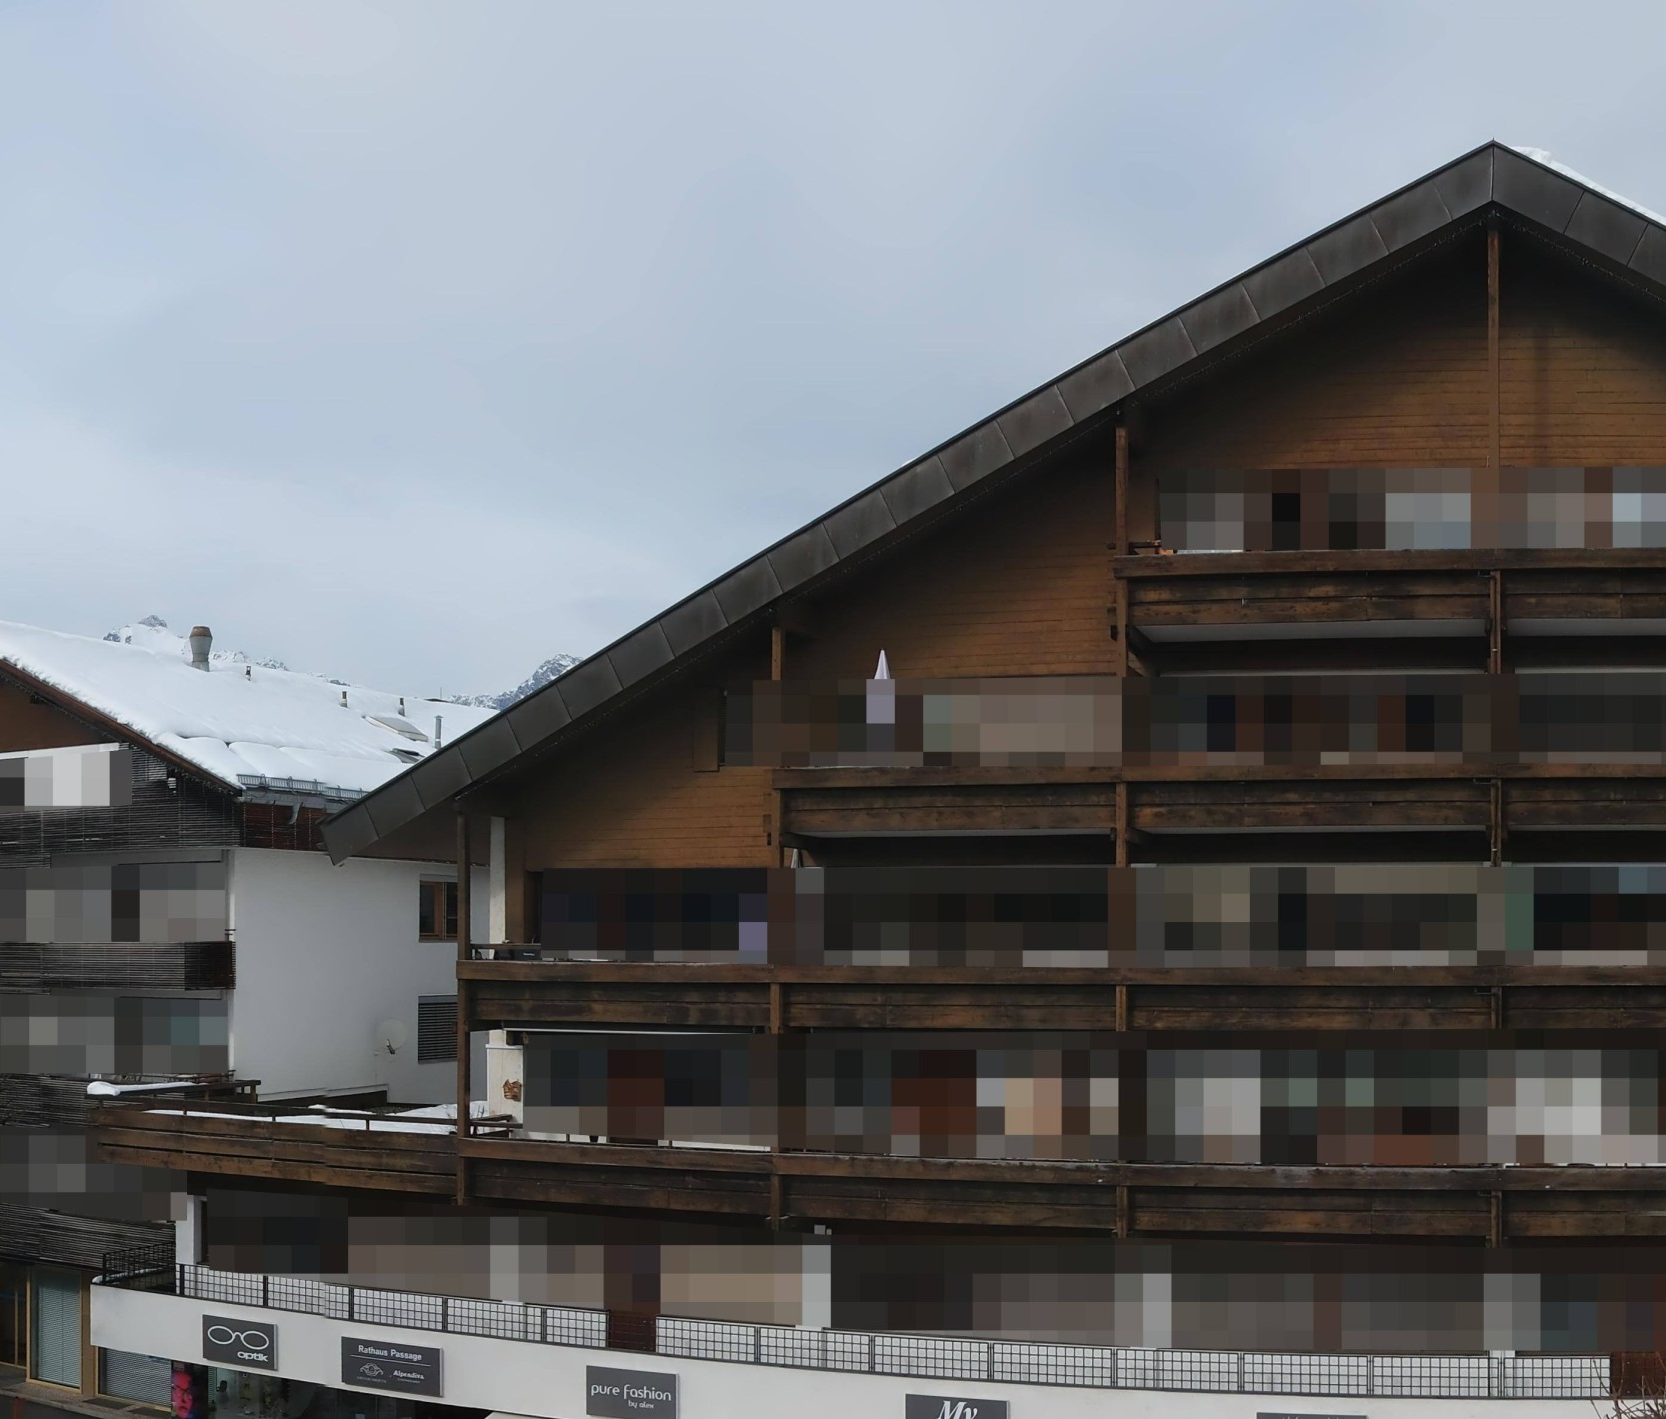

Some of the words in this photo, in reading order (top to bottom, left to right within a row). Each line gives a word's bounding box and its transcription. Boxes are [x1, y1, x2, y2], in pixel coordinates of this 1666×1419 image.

[237, 1351, 269, 1363] optik
[358, 1344, 388, 1357] Rathaus
[390, 1349, 423, 1362] Passage
[590, 1384, 620, 1397] pure
[623, 1384, 672, 1402] fashion
[628, 1400, 638, 1409] by
[639, 1401, 654, 1409] alex
